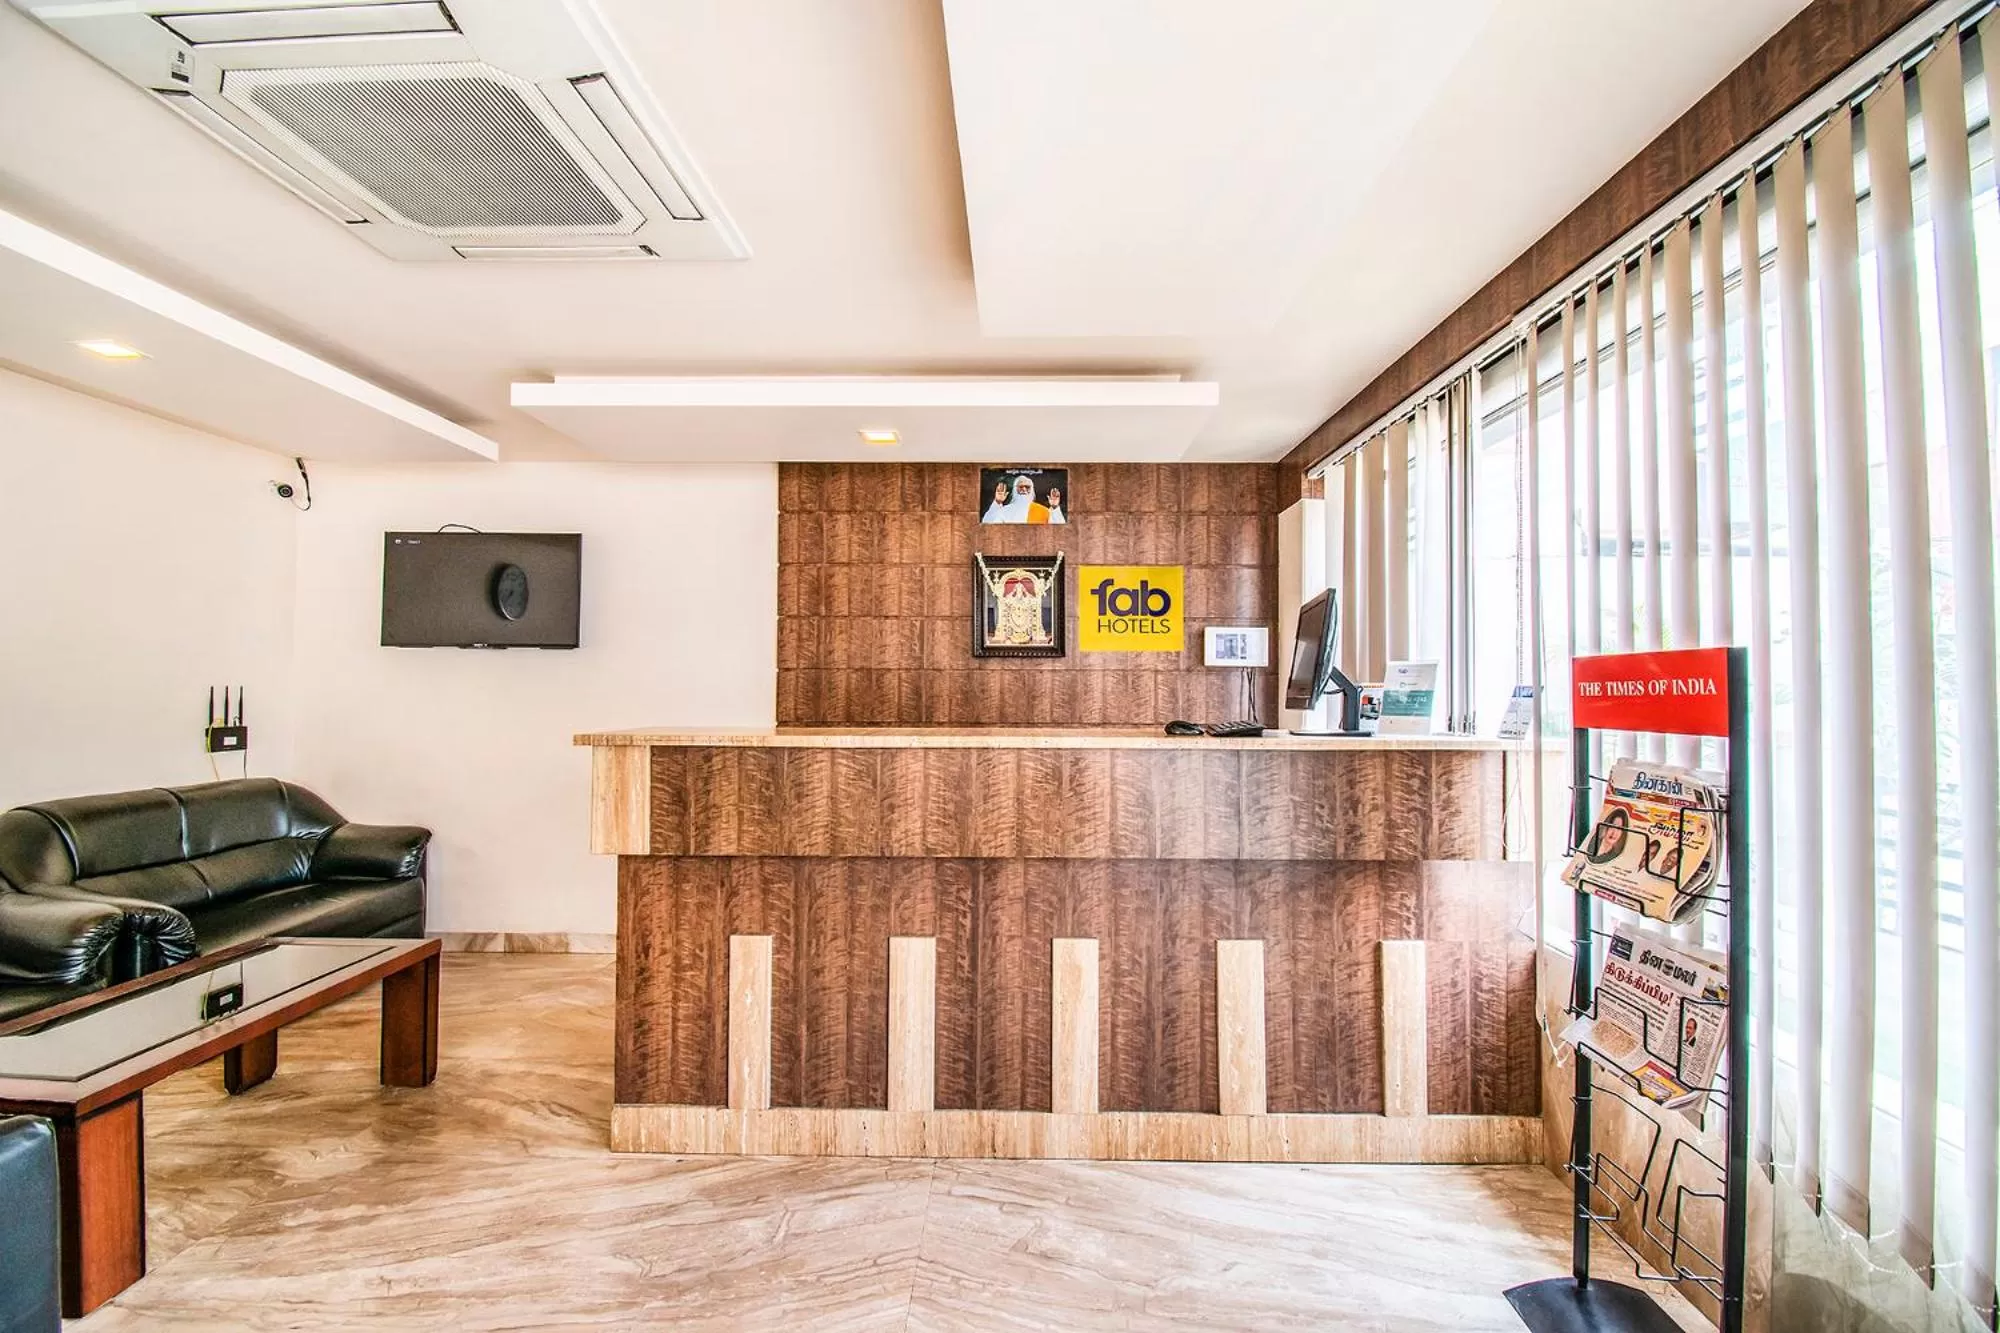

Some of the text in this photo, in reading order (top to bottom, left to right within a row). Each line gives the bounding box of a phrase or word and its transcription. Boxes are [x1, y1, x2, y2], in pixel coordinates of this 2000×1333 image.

[1090, 578, 1171, 617] fab
[1097, 618, 1171, 634] HOTELS
[1578, 678, 1717, 697] THE TIMES OF INDIA
